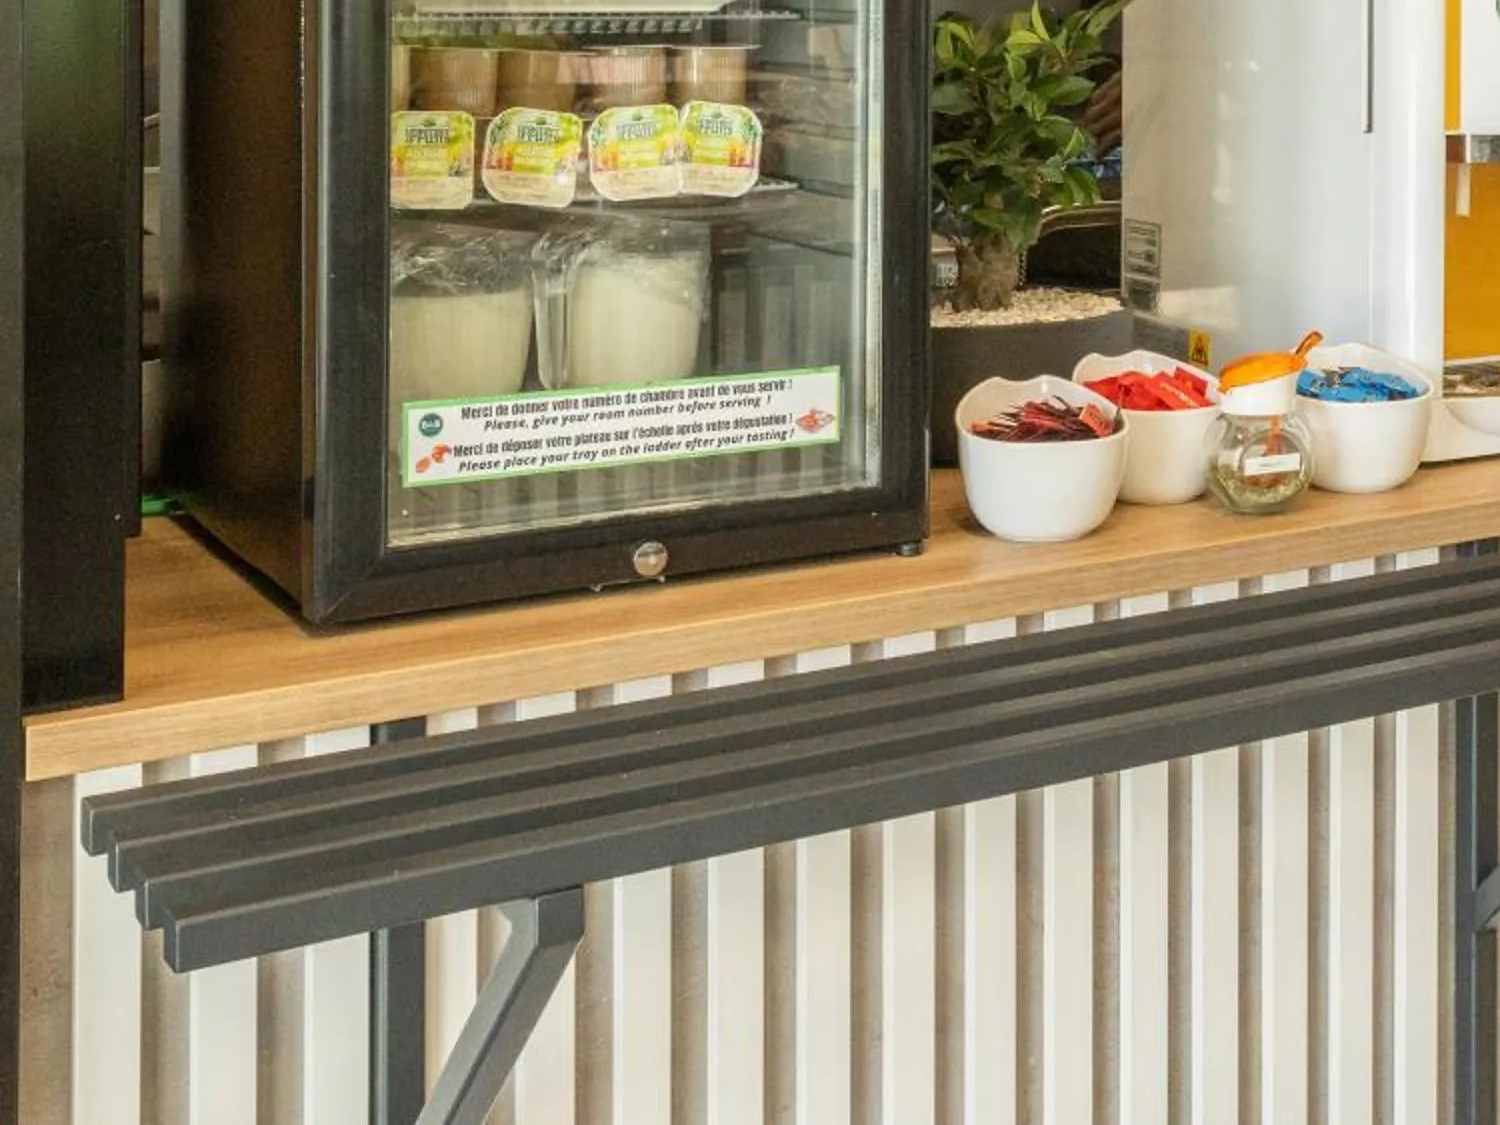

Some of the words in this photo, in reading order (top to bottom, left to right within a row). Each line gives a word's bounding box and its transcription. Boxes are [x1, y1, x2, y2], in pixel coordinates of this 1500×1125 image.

[461, 405, 492, 420] Merci
[496, 404, 509, 417] de
[512, 401, 548, 416] donner
[552, 398, 579, 412] votre
[582, 393, 621, 408] numéro
[625, 392, 637, 404] de
[688, 386, 715, 399] avant
[718, 385, 729, 396] de
[733, 382, 755, 395] vous
[758, 379, 786, 392] servir
[484, 418, 529, 432] Please,
[533, 414, 558, 430] give
[562, 411, 589, 425] your
[593, 409, 625, 422] room
[628, 404, 674, 418] number
[678, 400, 716, 414] before
[719, 395, 761, 410] serving
[454, 441, 483, 457] Merci
[486, 440, 499, 454] de
[502, 437, 543, 453] déposer
[546, 435, 572, 449] votre
[574, 430, 611, 446] plateau
[614, 429, 629, 441] sur
[676, 421, 703, 437] après
[706, 419, 731, 432] votre
[458, 460, 500, 473] Please
[504, 455, 537, 470] place
[540, 451, 569, 466] your
[572, 448, 598, 463] tray
[601, 447, 617, 458] on
[619, 443, 640, 456] the
[643, 438, 682, 453] ladder
[685, 436, 715, 452] after
[717, 433, 744, 448] your
[747, 428, 787, 444] tasting
